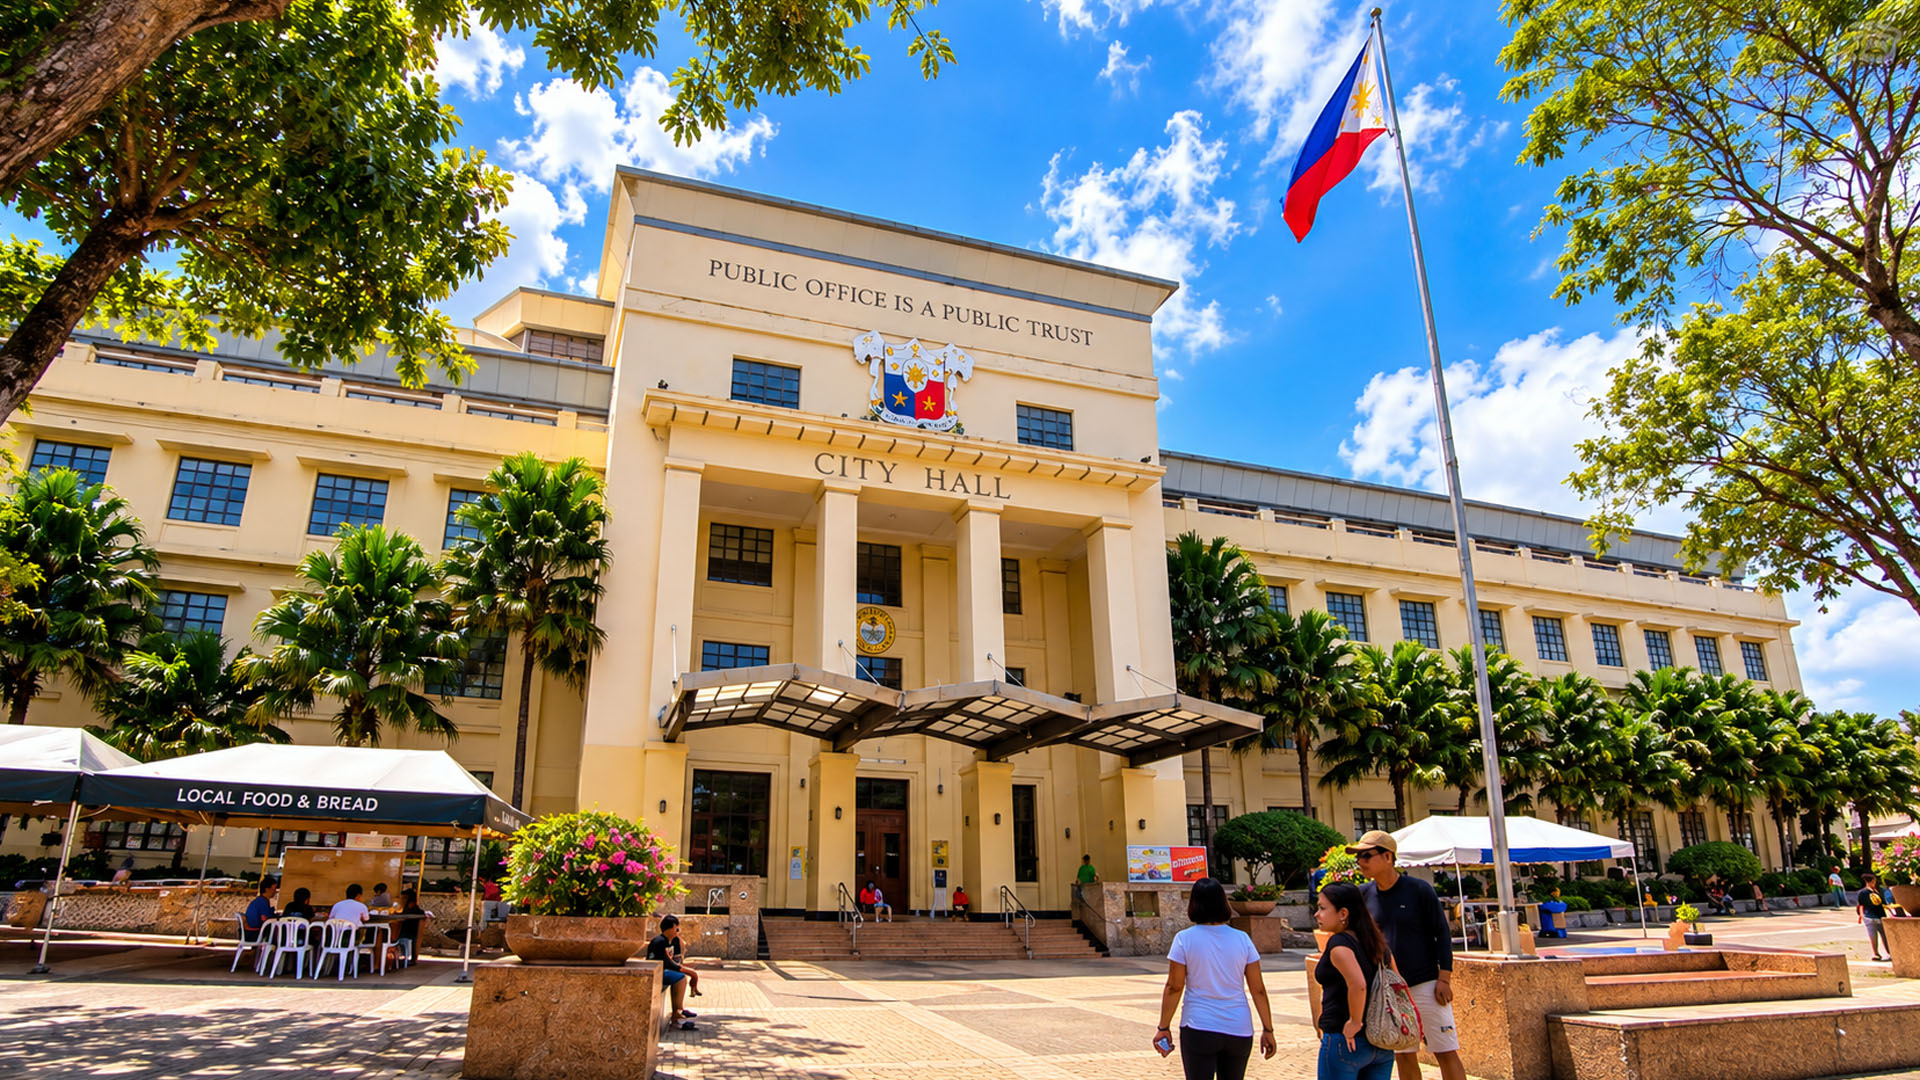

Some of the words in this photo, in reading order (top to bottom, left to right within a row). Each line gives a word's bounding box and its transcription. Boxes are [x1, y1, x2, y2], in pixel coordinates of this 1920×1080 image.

[709, 259, 798, 292] PUBLIC
[805, 278, 887, 308] OFFICE
[894, 294, 914, 313] IS
[921, 300, 936, 318] A
[943, 303, 1020, 334] PUBLIC
[1026, 319, 1094, 347] TRUST
[814, 452, 898, 484] CITY
[925, 467, 1011, 500] HALL
[176, 788, 236, 805] LOCAL
[242, 791, 293, 808] FOOD
[297, 794, 311, 809] &
[317, 795, 379, 812] BREAD
